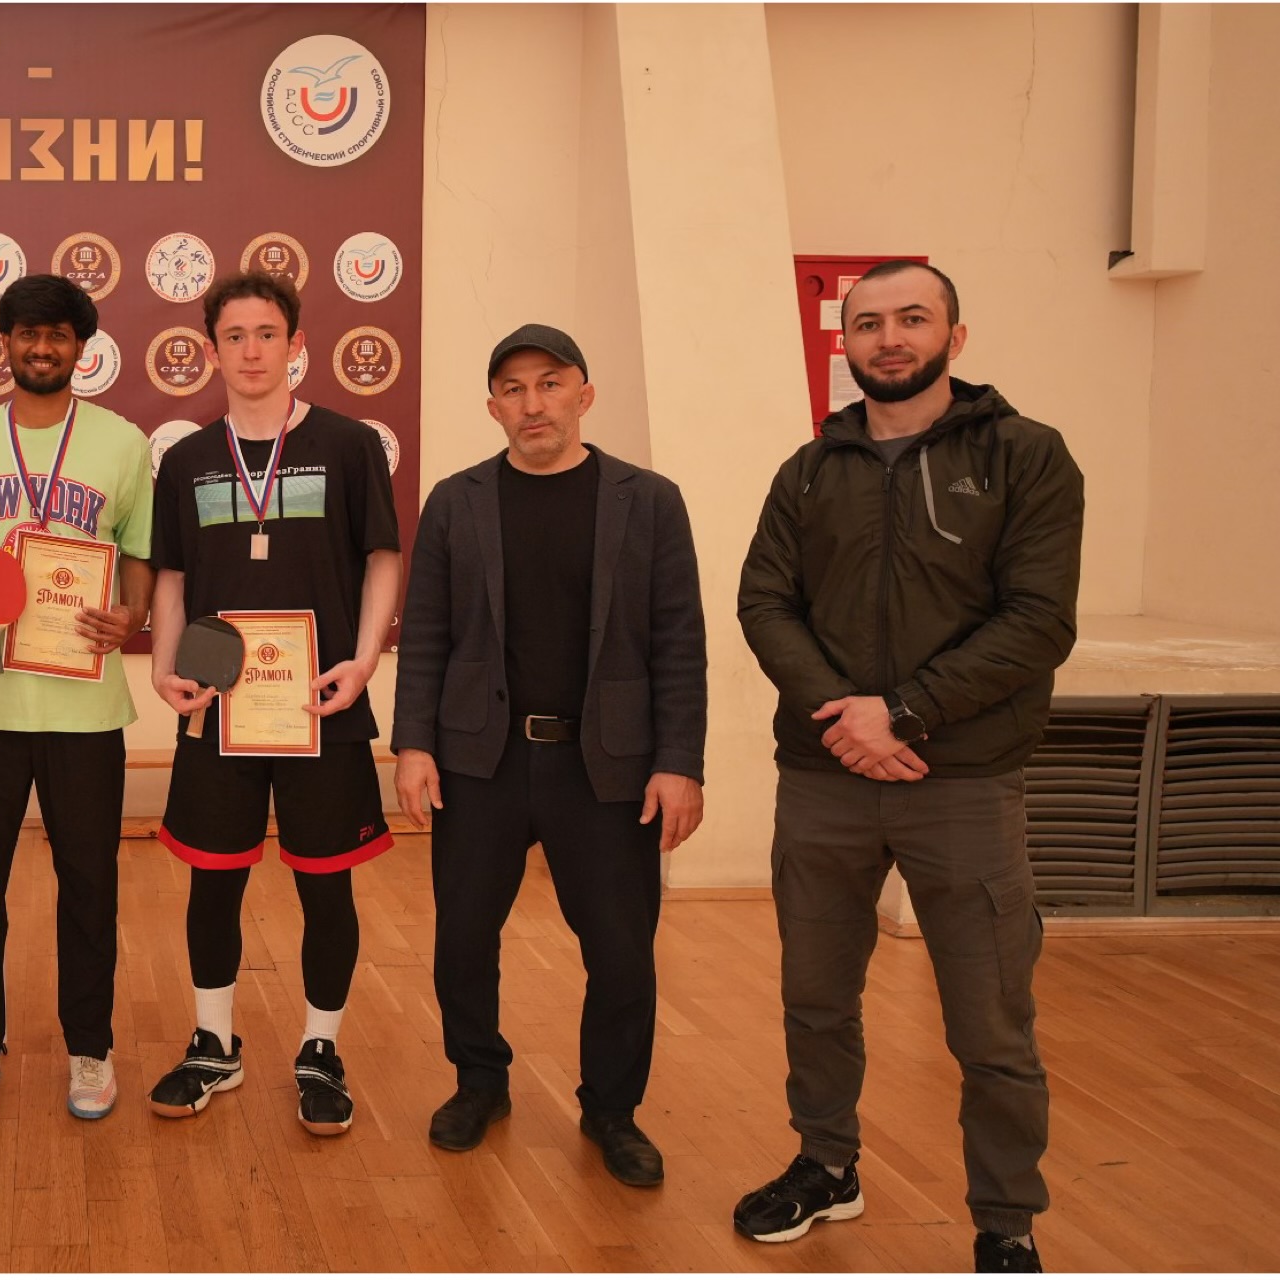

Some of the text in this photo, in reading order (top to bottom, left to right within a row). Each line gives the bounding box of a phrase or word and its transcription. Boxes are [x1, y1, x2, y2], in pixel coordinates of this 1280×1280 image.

[66, 271, 106, 279] СКГА
[160, 365, 200, 373] СКГА
[27, 474, 107, 540] YORK
[36, 588, 84, 608] ГРАМОТА
[245, 667, 293, 684] ГРАМОТА
